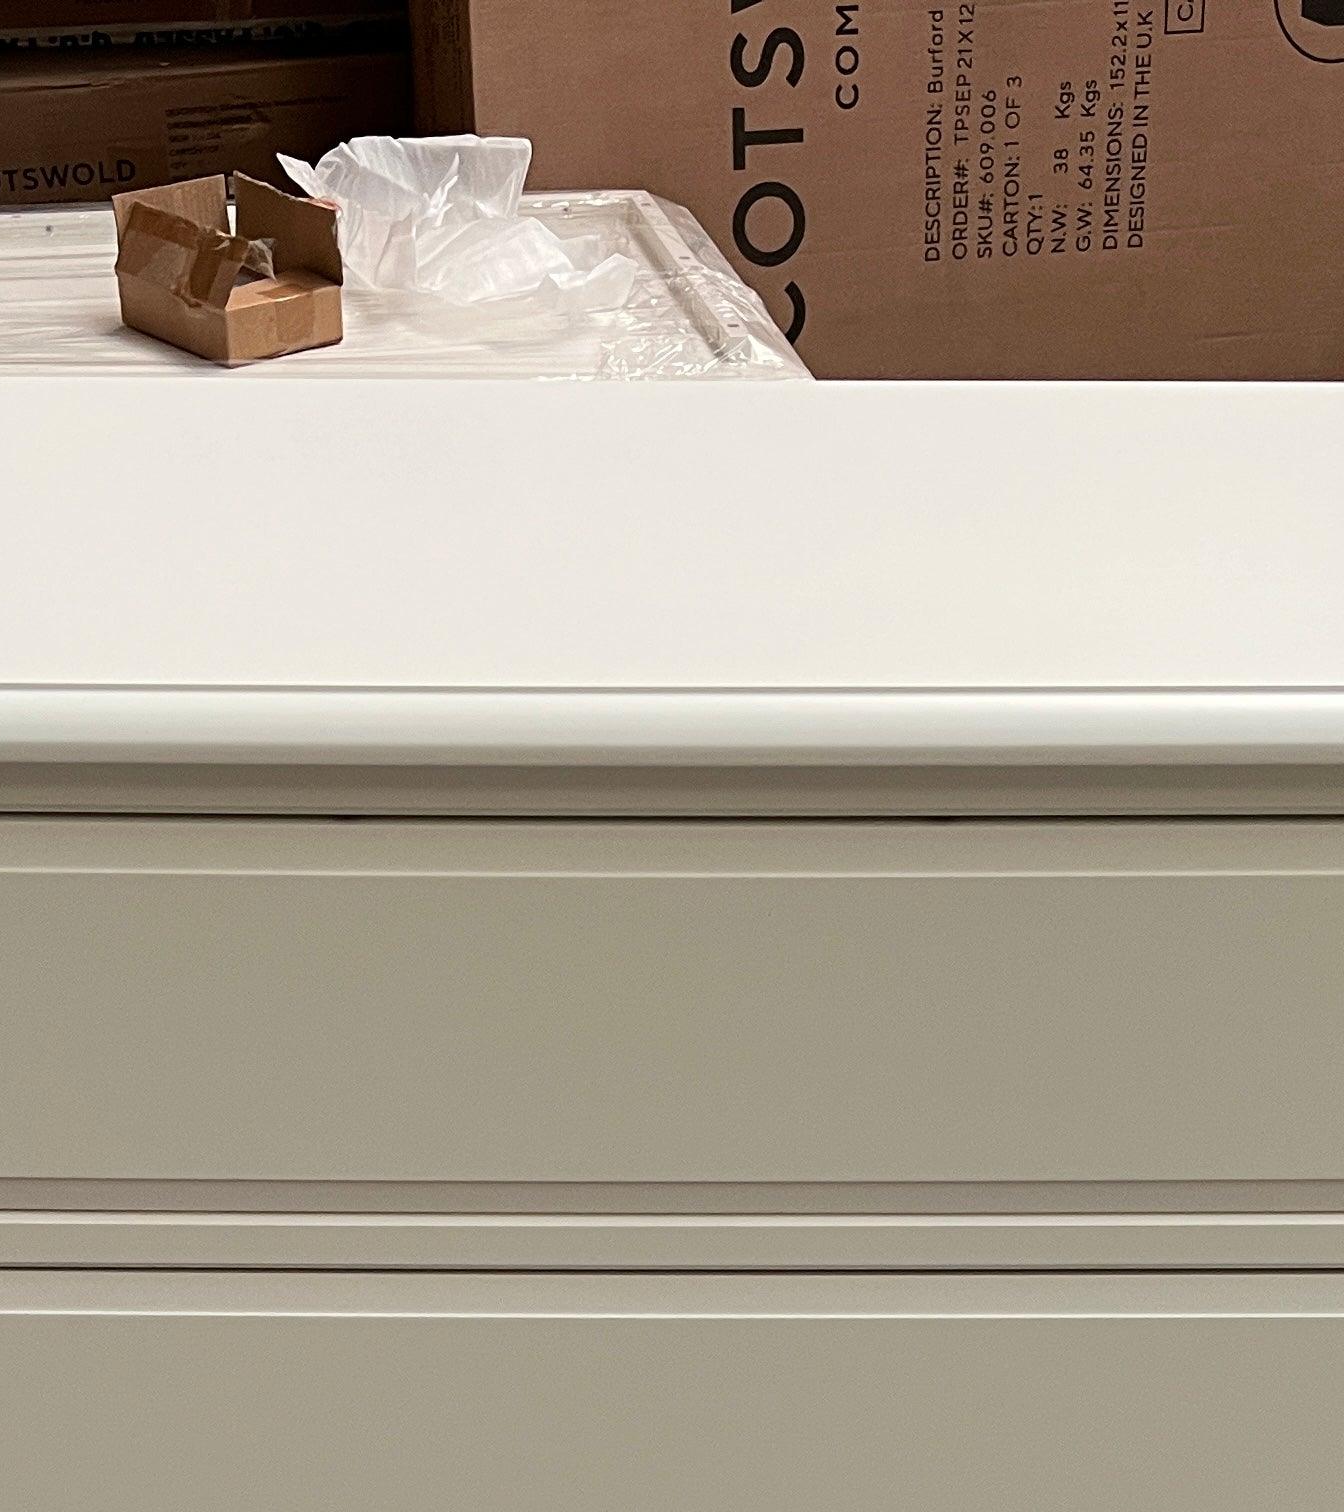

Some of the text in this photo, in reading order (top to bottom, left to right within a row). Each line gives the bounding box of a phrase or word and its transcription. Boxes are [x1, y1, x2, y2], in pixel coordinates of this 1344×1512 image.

[835, 4, 860, 110] COM
[1006, 76, 1023, 88] 3
[1177, 0, 1194, 21] C
[730, 0, 805, 346] OTS
[925, 10, 943, 262] DESCRIPTION: Burford
[977, 90, 997, 259] SKU#: 609.006
[1005, 97, 1021, 129] OF
[1051, 81, 1075, 253] N.W: 38 Kgs
[1076, 80, 1101, 252] G.W: 64.35 Kgs
[1103, 102, 1124, 250] DIMENSIONS:
[1127, 10, 1154, 248] DESIGNED IN THE U.K
[952, 158, 969, 260] ORDER#:
[1002, 156, 1020, 257] CARTON:
